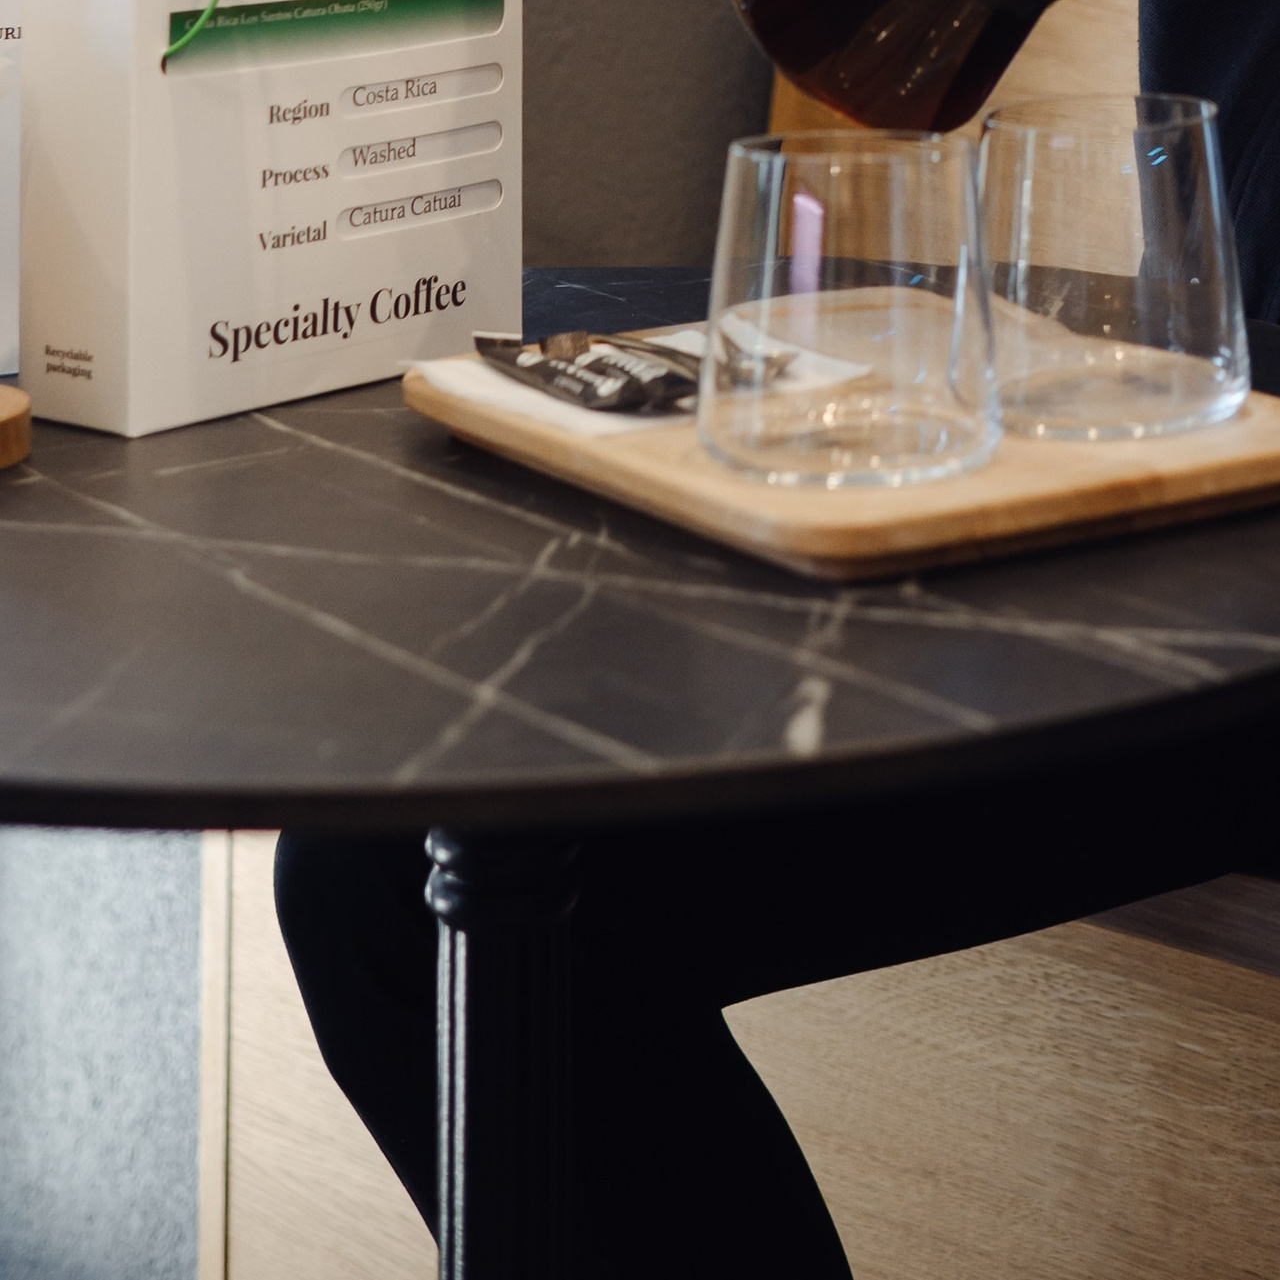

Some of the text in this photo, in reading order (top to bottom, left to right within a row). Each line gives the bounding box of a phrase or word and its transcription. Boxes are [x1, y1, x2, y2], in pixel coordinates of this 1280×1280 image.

[269, 79, 437, 125] Region Costa Rica
[261, 137, 417, 189] Process Washed
[258, 220, 328, 251] Varietal
[349, 205, 406, 228] Catura
[208, 274, 467, 363] Specialty Coffee
